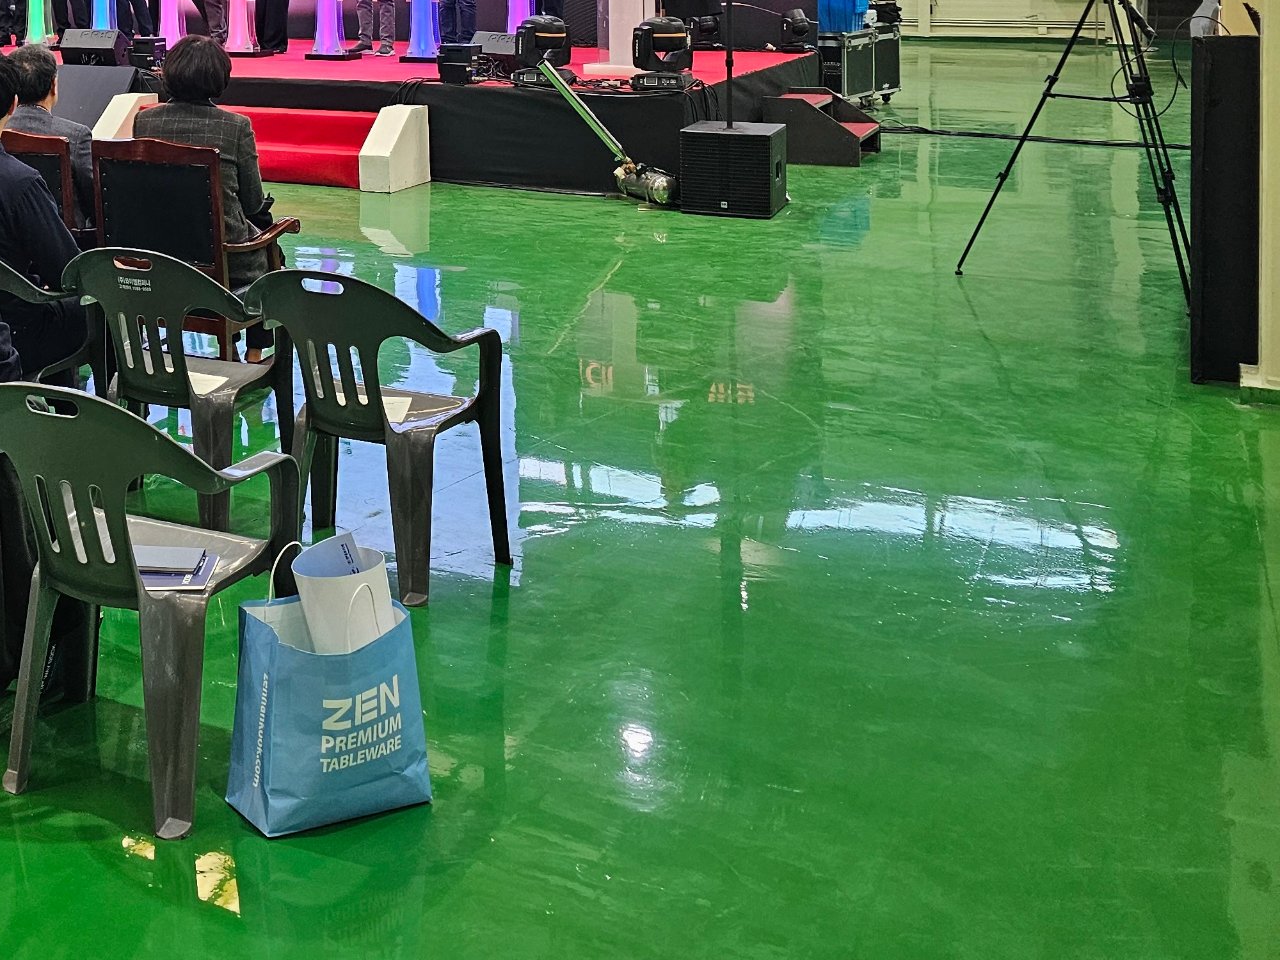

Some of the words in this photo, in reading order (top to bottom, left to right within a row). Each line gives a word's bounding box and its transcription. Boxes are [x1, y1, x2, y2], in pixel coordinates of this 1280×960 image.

[322, 674, 400, 731] ZEN
[320, 735, 402, 773] TABLEWARE
[321, 713, 402, 754] PREMIUM
